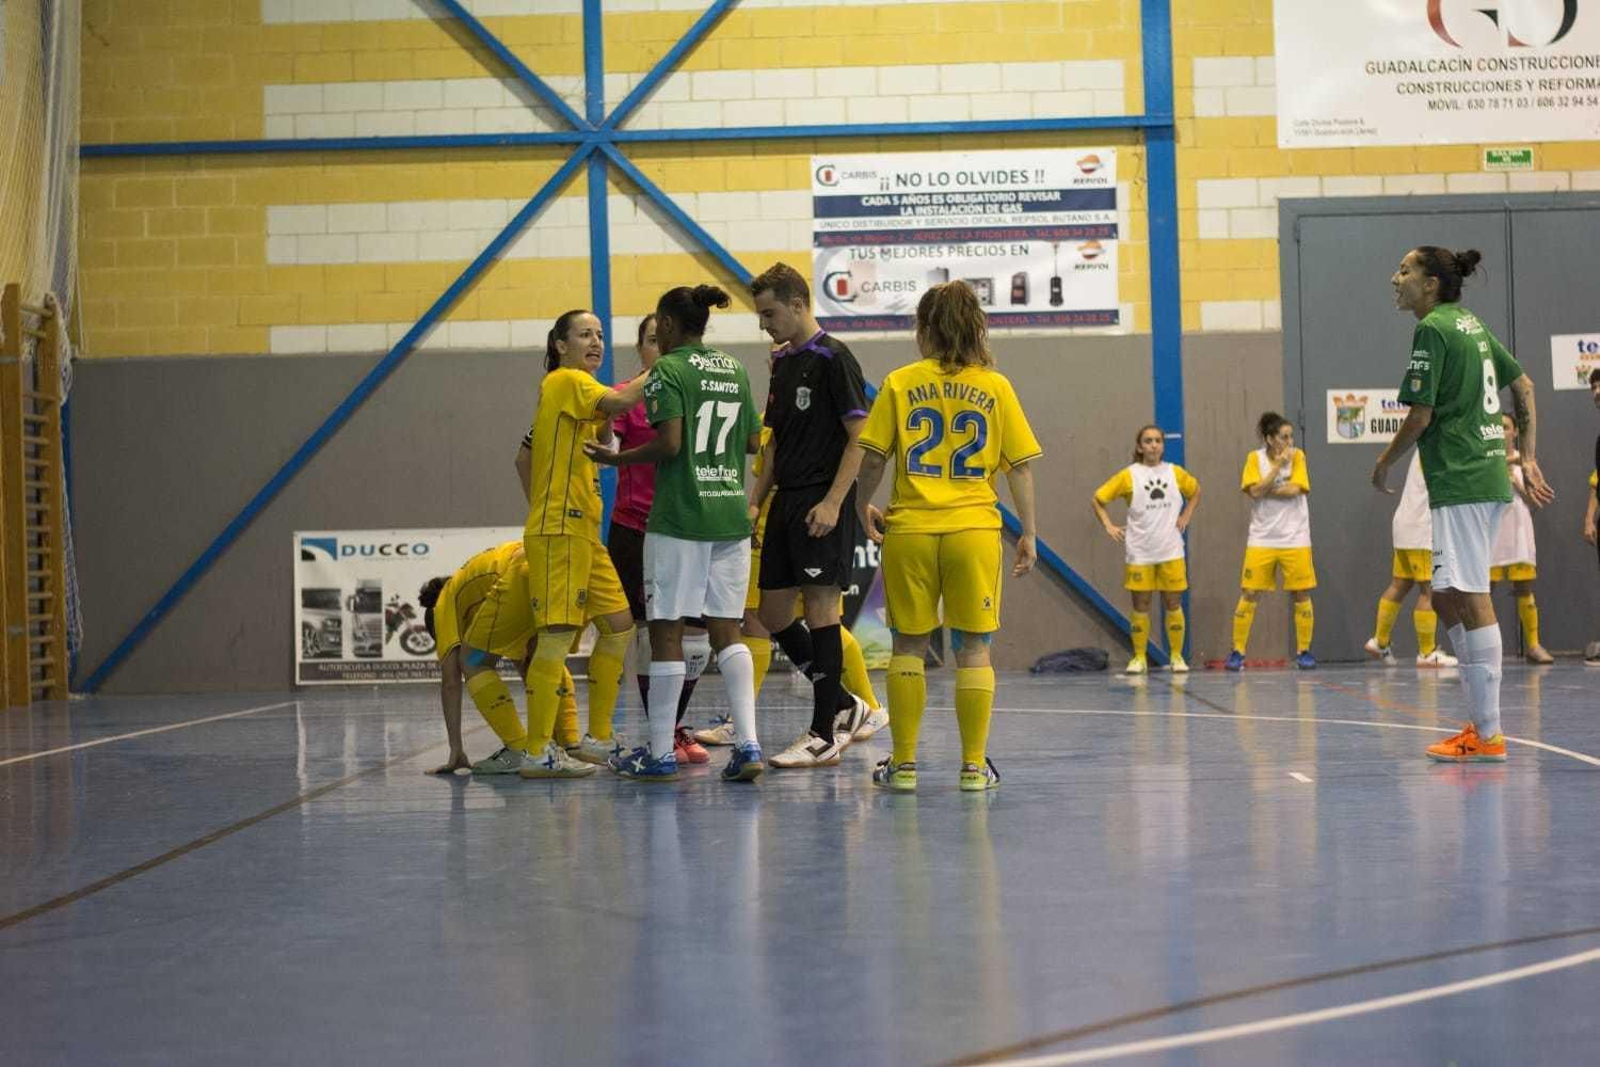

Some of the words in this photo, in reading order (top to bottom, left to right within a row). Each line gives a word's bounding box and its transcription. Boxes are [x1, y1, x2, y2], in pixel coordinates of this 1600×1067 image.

[1396, 80, 1522, 95] CONSTRUCCIONES
[1526, 80, 1535, 92] Y
[1539, 78, 1600, 91] REFORM
[1467, 98, 1485, 110] 630
[1557, 96, 1569, 107] 32
[1572, 95, 1583, 106] 94
[1587, 95, 1598, 106] 54
[841, 171, 877, 180] CARBIS
[896, 173, 922, 187] NO
[928, 172, 950, 186] LO
[956, 169, 1029, 186] OLVIDES
[1034, 169, 1045, 184] !!
[861, 195, 891, 206] CADA
[892, 195, 900, 206] 5
[901, 193, 931, 206] AÑOS
[932, 194, 945, 205] ES
[946, 191, 1016, 204] OBLIGATORIO
[1018, 191, 1061, 202] REVISAR
[900, 206, 914, 216] LA
[915, 202, 984, 216] INSTALACIÓN
[986, 203, 1000, 214] DE
[1001, 203, 1024, 213] GAS
[925, 216, 969, 226] SERVICIO
[972, 215, 1007, 225] OFICIAL
[1011, 213, 1048, 223] REPSOL
[1052, 212, 1092, 222] BUTANO
[850, 248, 876, 260] TUS
[880, 246, 943, 259] MEJORES
[948, 245, 1006, 258] PRECIOS
[1010, 244, 1029, 256] EN
[861, 281, 917, 293] CARBIS
[700, 379, 739, 394] S.SANTOS
[1483, 358, 1500, 414] 8
[907, 382, 940, 406] ANA
[943, 382, 996, 414] RIVERA
[695, 400, 742, 456] 17
[906, 407, 988, 480] 22
[341, 543, 430, 557] DUCCO
